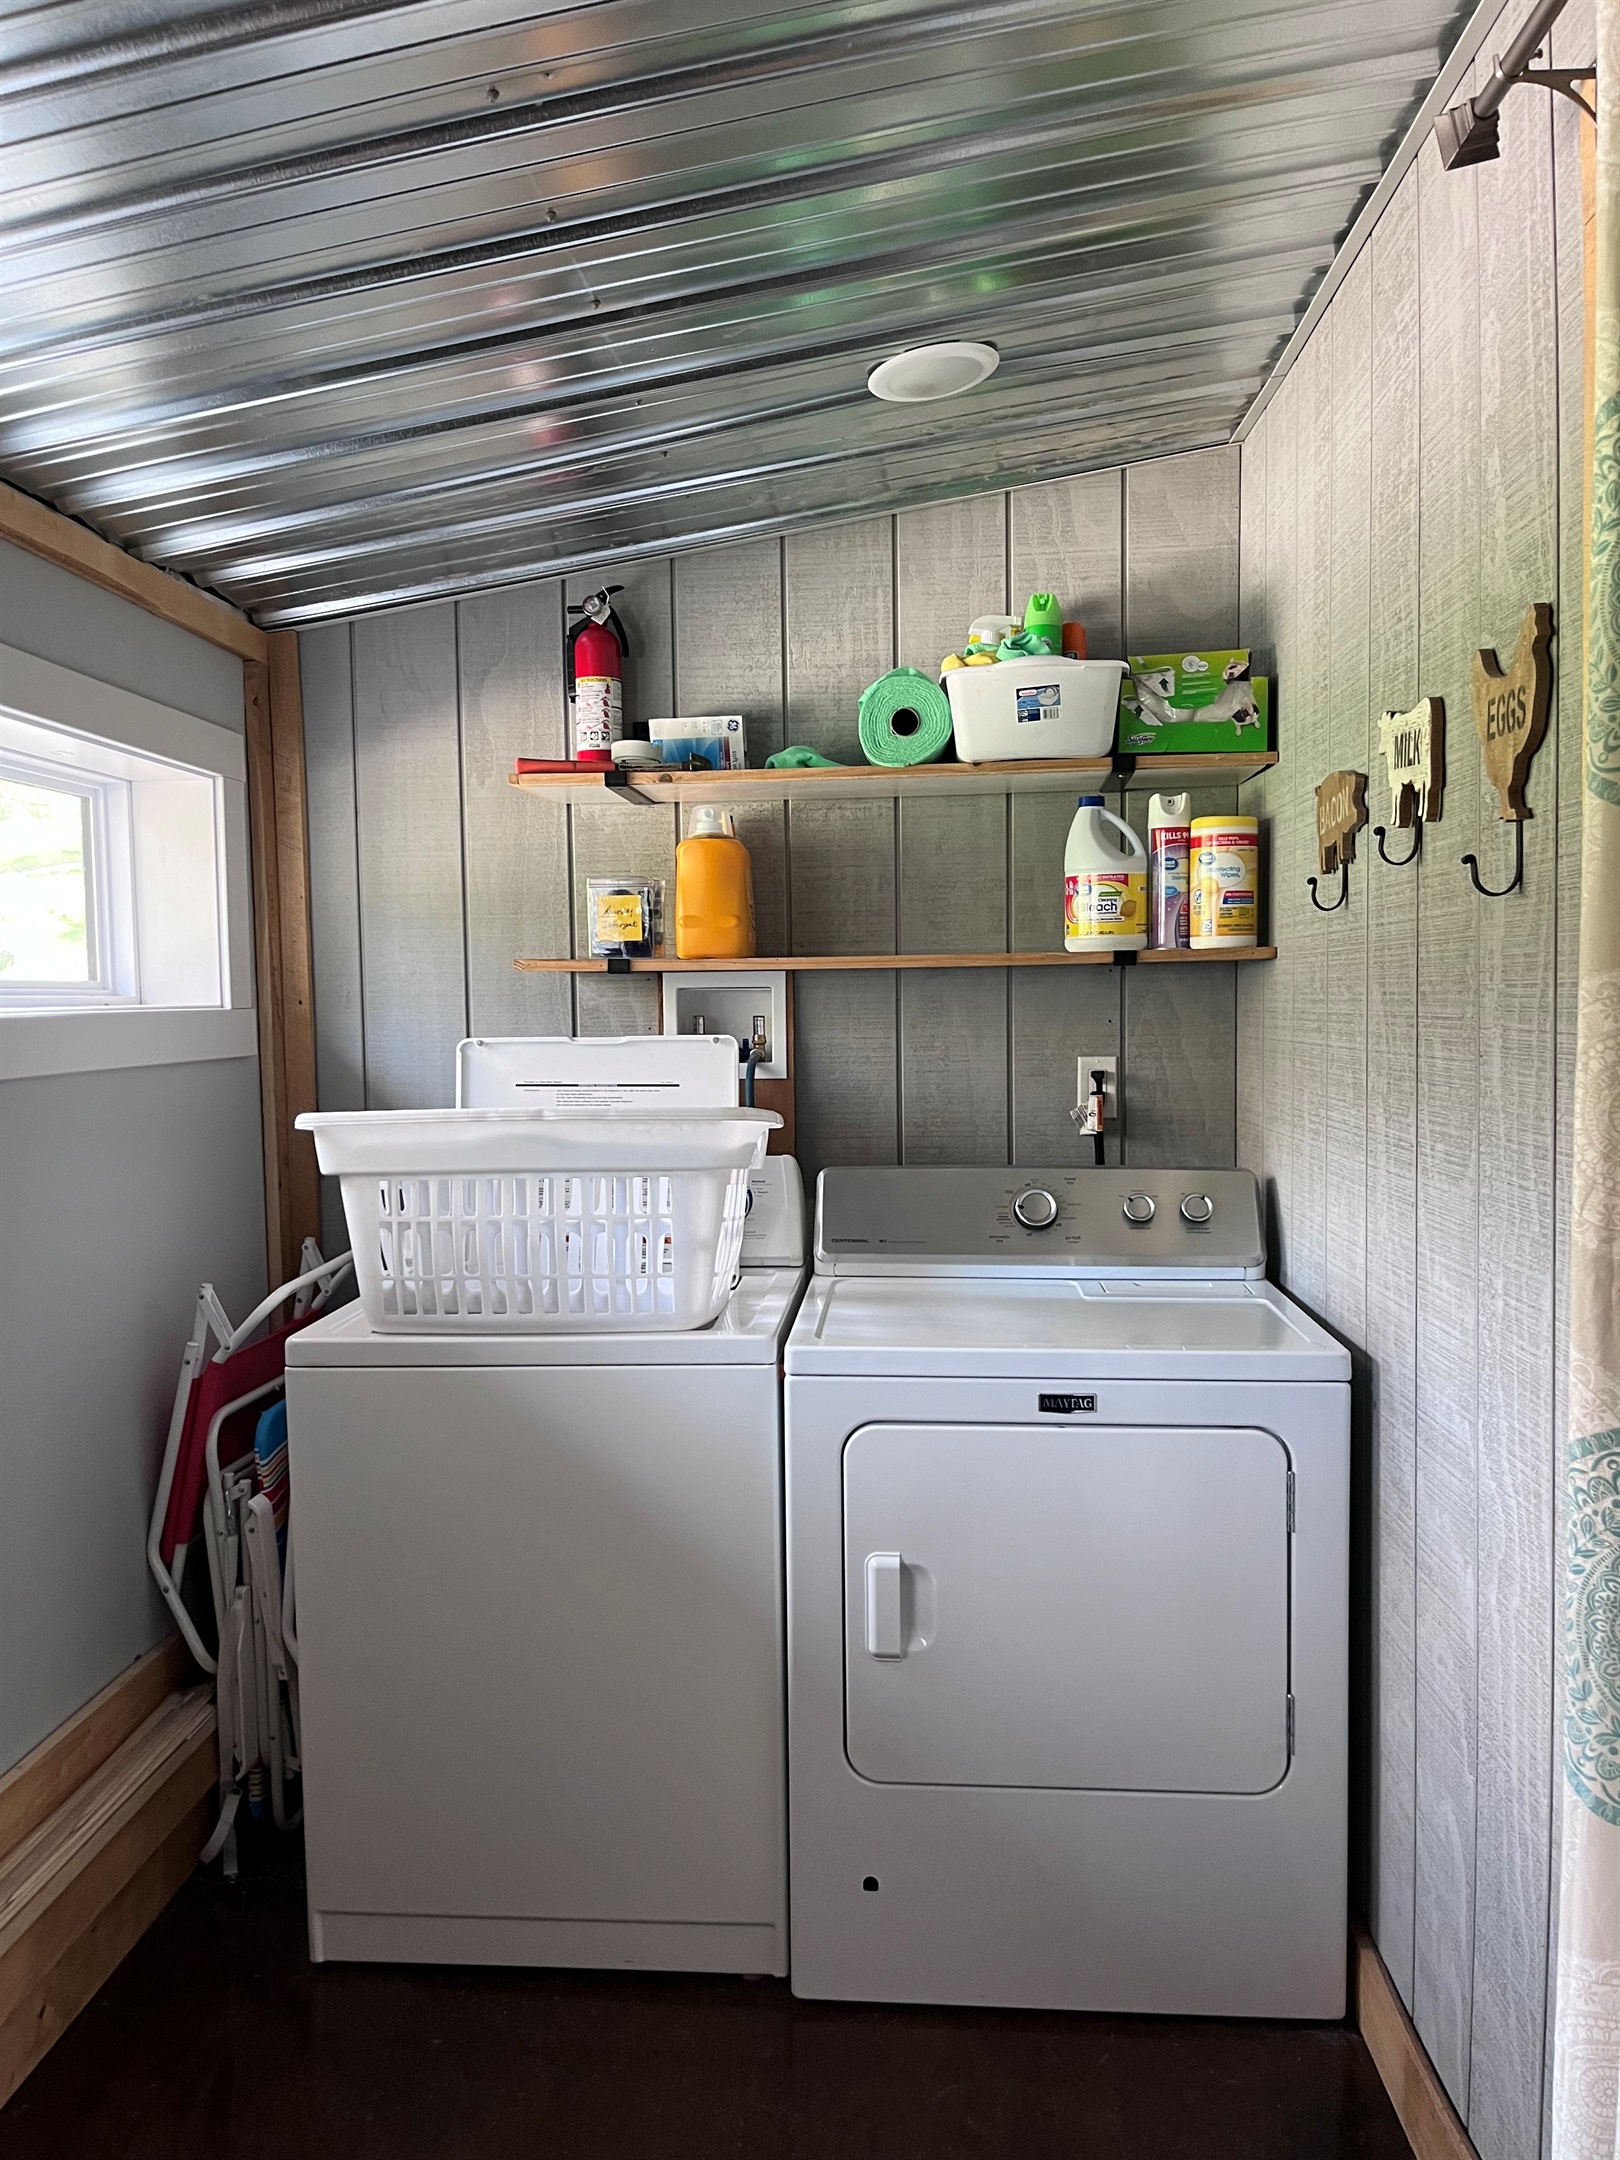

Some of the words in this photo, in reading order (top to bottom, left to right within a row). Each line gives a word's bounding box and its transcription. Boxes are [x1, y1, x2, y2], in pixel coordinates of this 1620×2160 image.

[1487, 685, 1526, 741] EGGS
[1126, 734, 1156, 745] Swiffer
[1393, 729, 1421, 770] MILK
[1320, 786, 1349, 836] BACON
[1161, 832, 1182, 840] KILLS
[1043, 1398, 1093, 1408] MAYTAG
